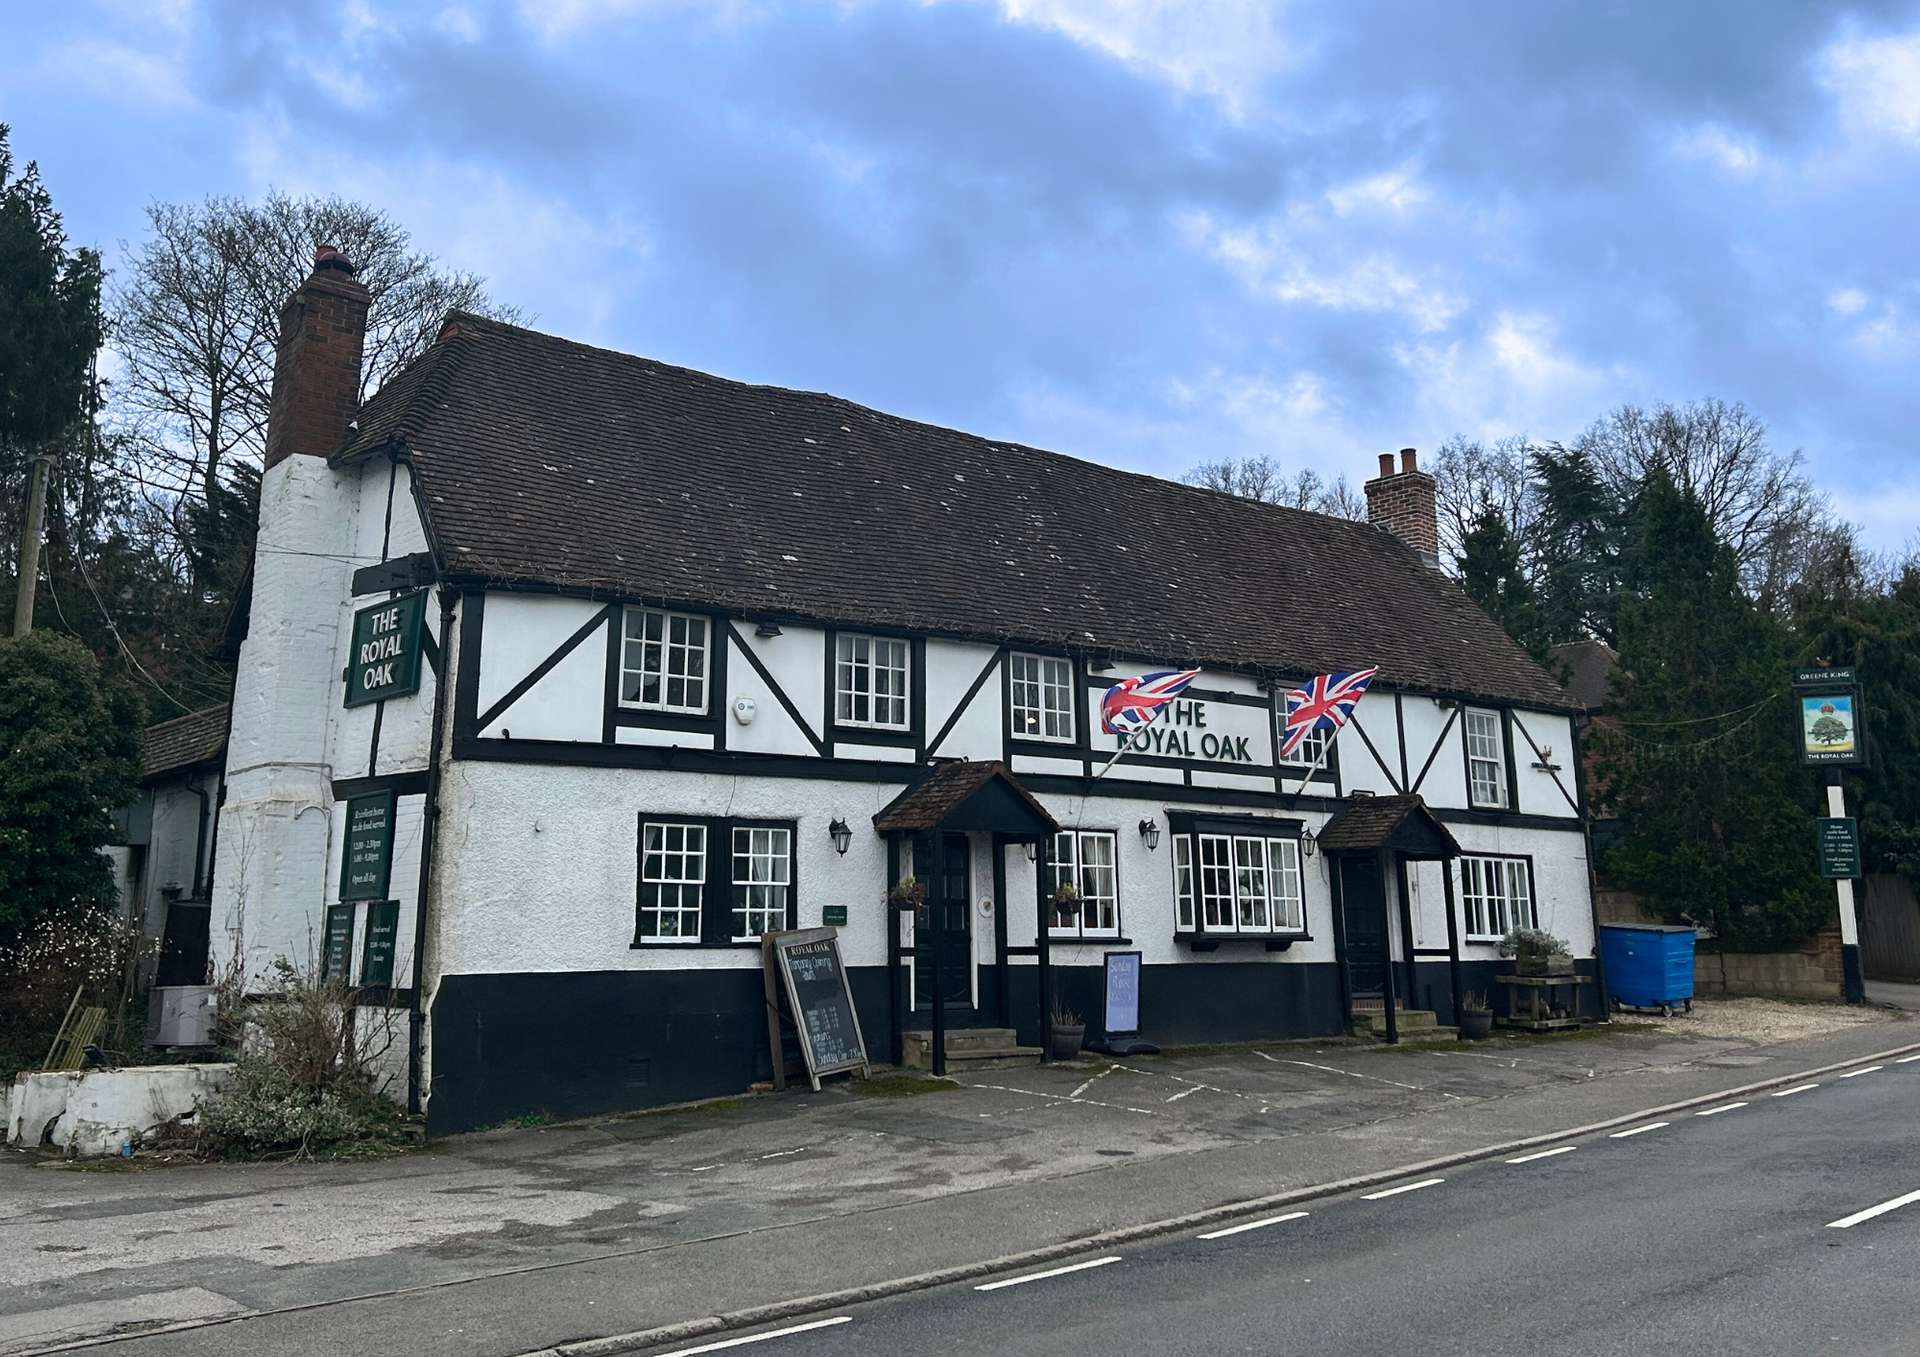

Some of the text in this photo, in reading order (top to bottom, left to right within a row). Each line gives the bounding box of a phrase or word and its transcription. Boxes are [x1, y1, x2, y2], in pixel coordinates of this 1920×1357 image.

[372, 608, 398, 635] THE
[360, 634, 402, 665] ROYAL
[363, 662, 393, 690] OAK
[1830, 671, 1850, 679] KING
[1201, 733, 1253, 761] OAK
[791, 943, 830, 956] ROYAL OAK
